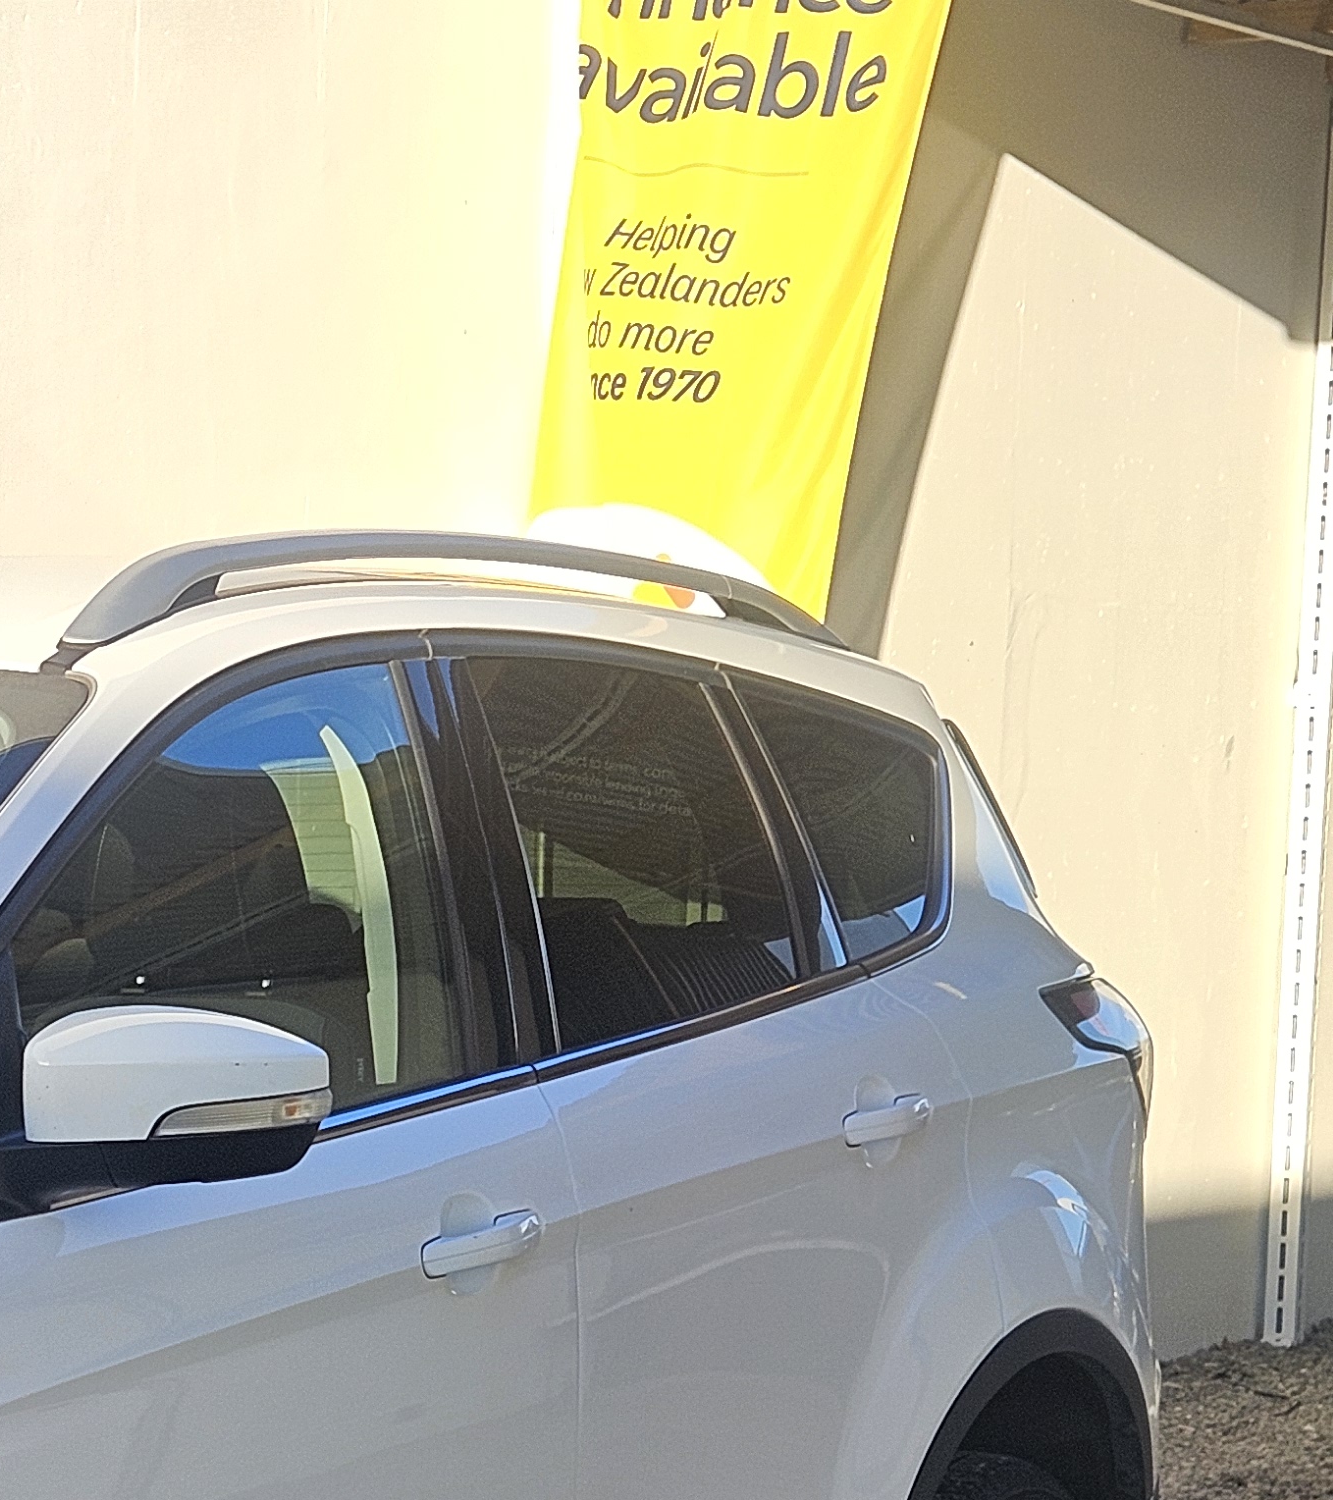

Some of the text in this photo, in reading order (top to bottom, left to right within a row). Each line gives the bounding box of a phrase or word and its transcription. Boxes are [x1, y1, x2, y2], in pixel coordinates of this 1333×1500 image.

[604, 213, 737, 263] Helping
[600, 261, 791, 308] Zealanders
[587, 310, 715, 356] do more
[637, 366, 722, 404] 1970
